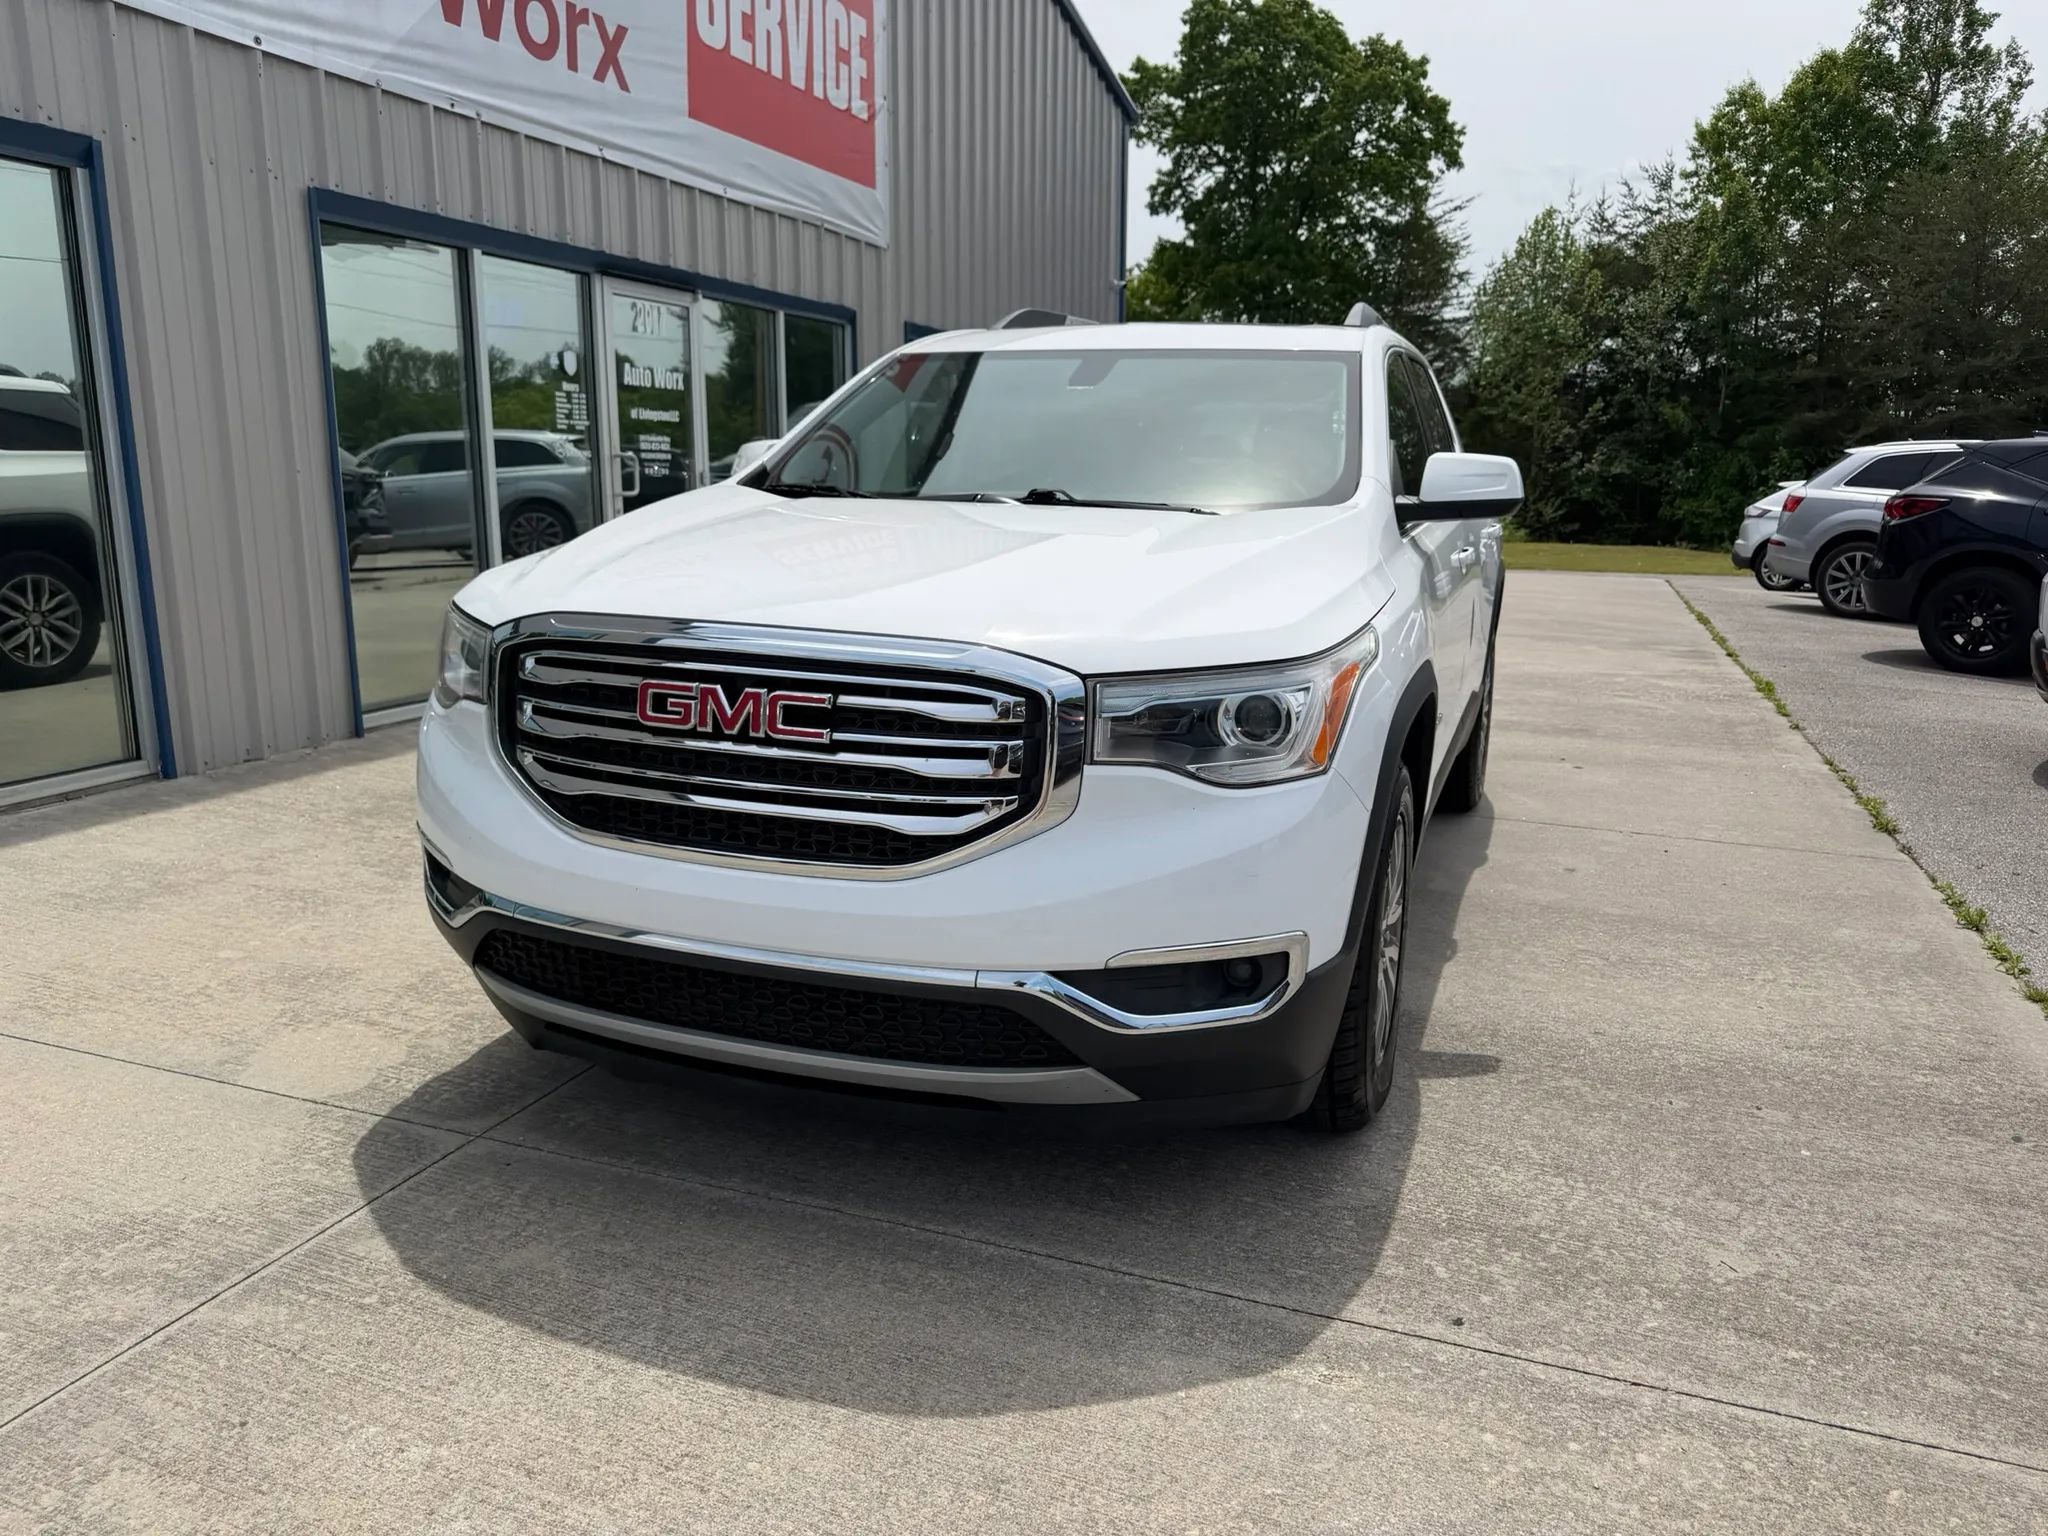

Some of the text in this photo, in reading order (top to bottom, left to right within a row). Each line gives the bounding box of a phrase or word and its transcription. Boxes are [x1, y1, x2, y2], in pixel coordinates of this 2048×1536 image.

[623, 362, 685, 391] Auto Worx
[637, 680, 833, 743] GMC
